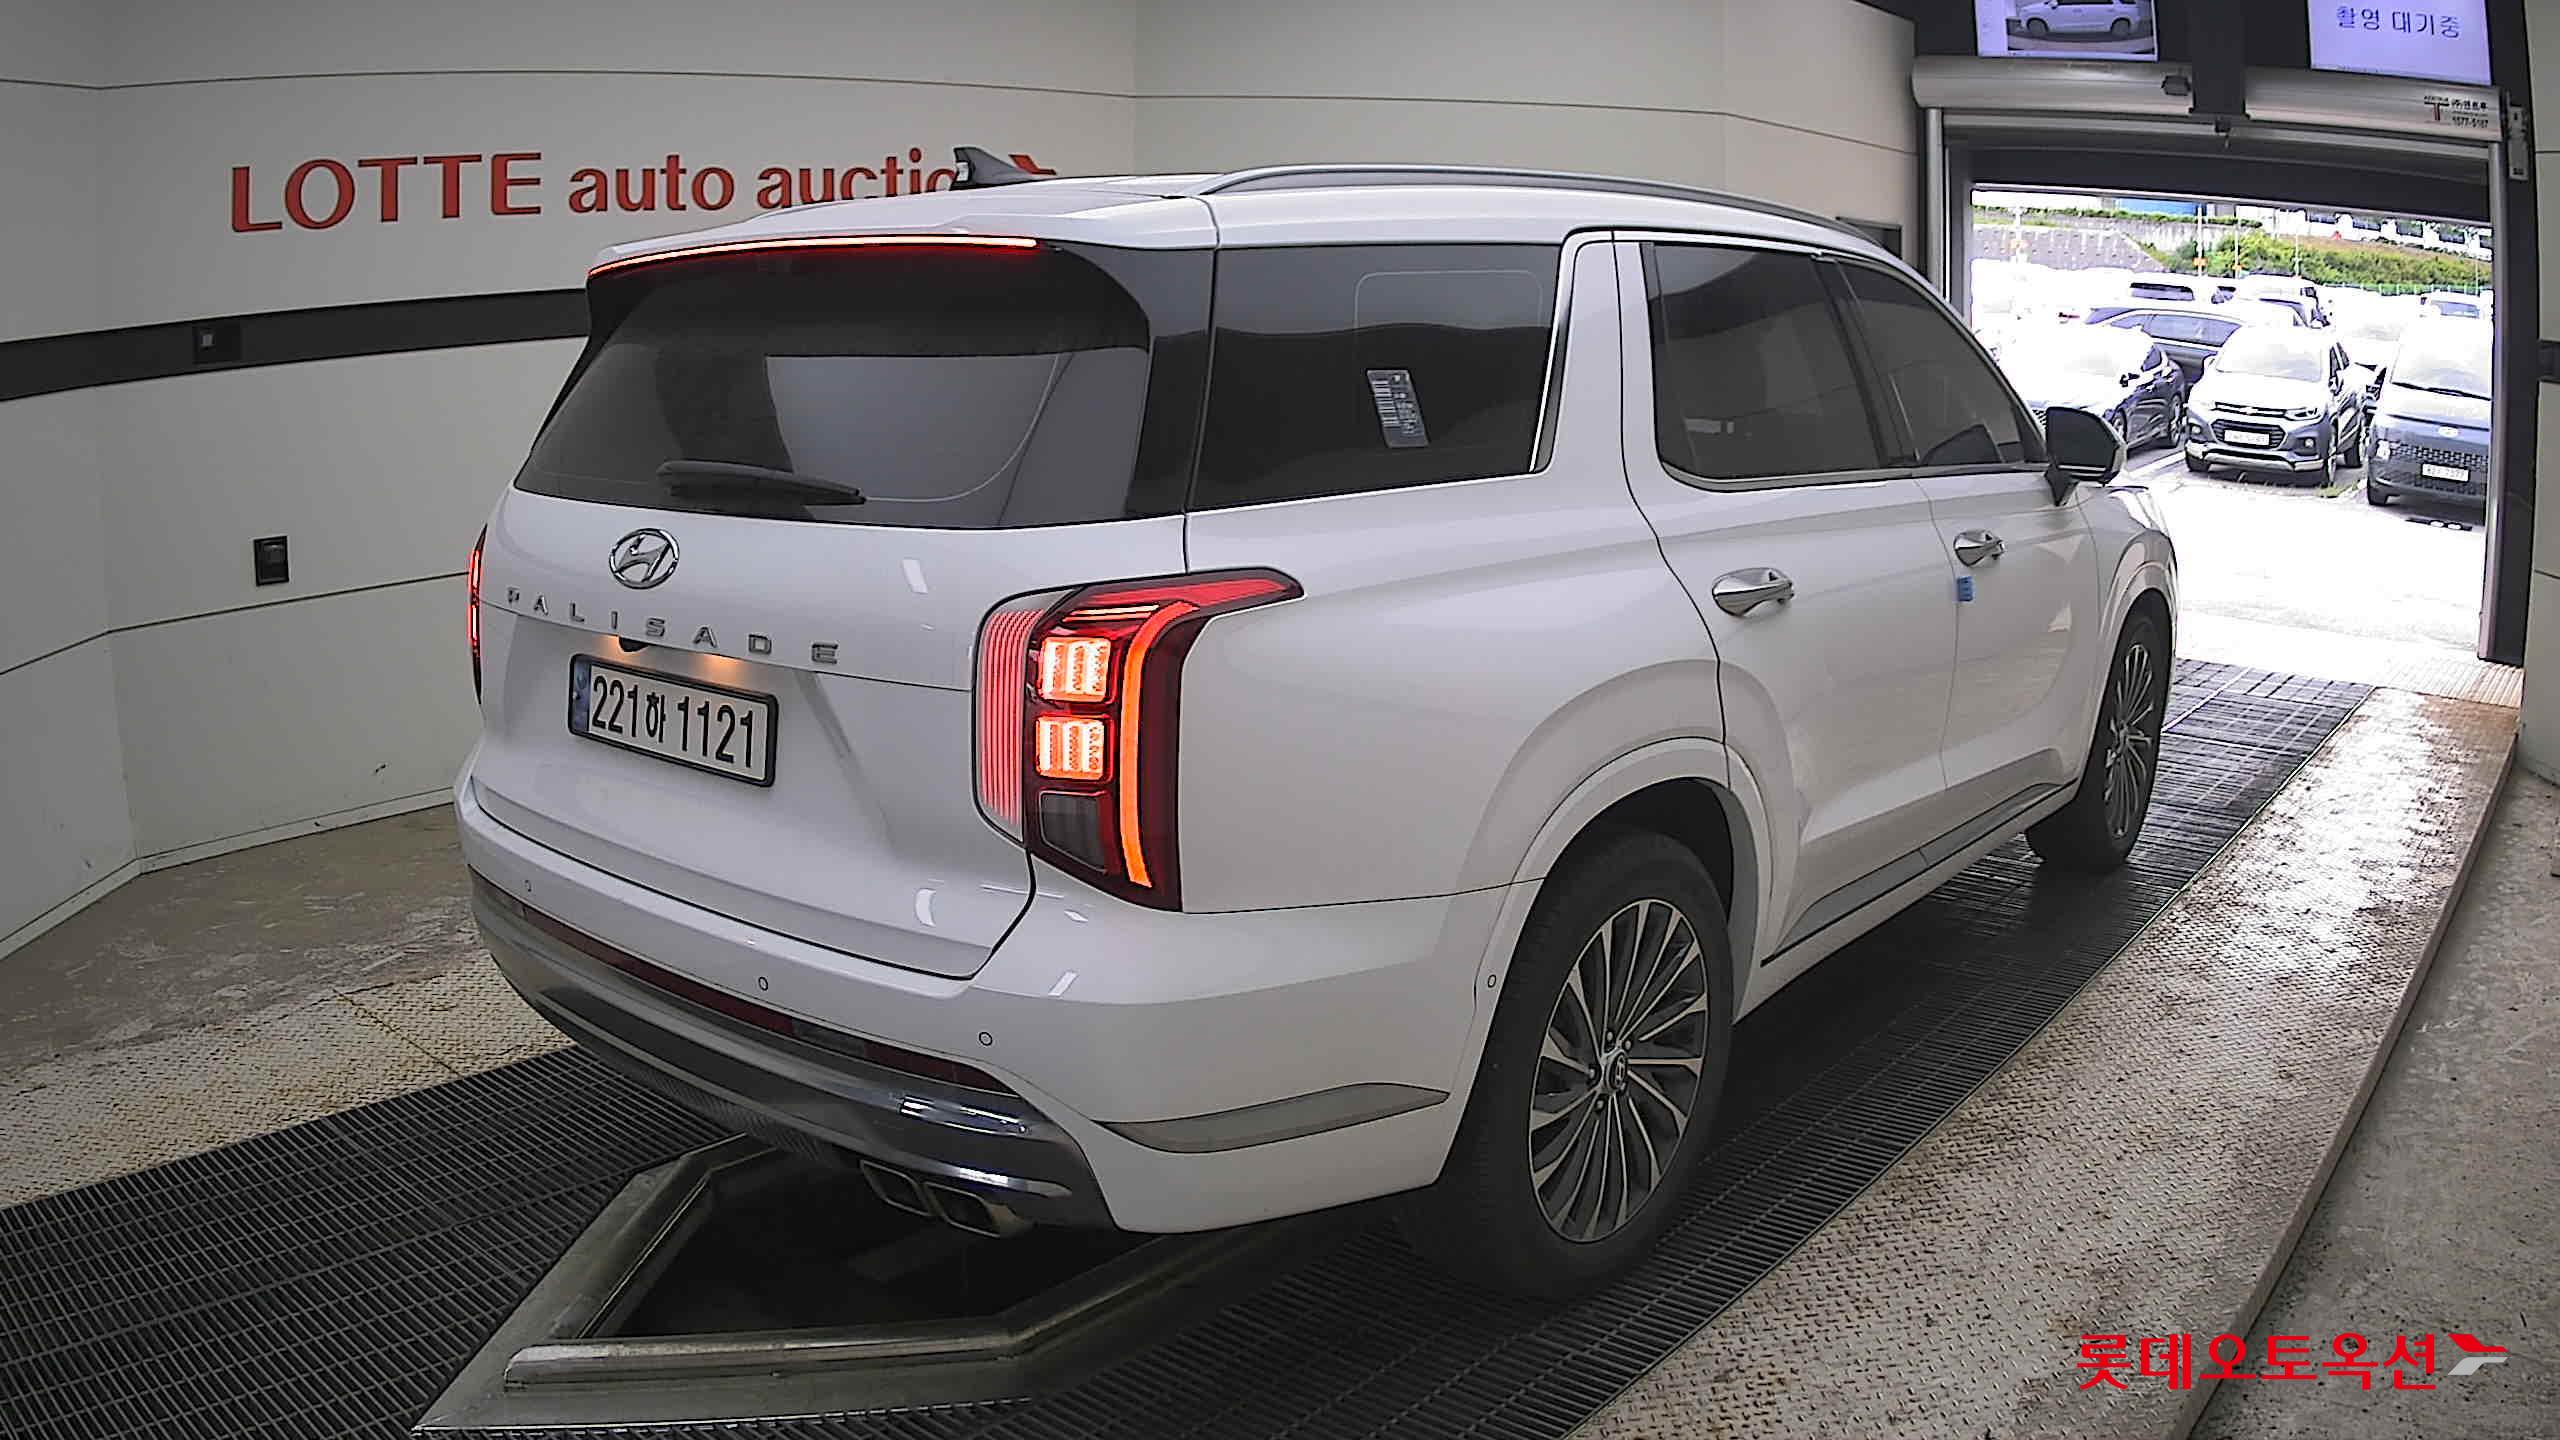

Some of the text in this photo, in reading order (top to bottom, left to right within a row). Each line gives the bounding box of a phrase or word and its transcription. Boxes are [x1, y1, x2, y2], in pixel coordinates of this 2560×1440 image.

[2336, 6, 2461, 39] 촬영 대기중
[231, 147, 957, 234] LOTTE auto auctio
[507, 586, 839, 666] PALISADE
[592, 674, 753, 769] 221하 1121
